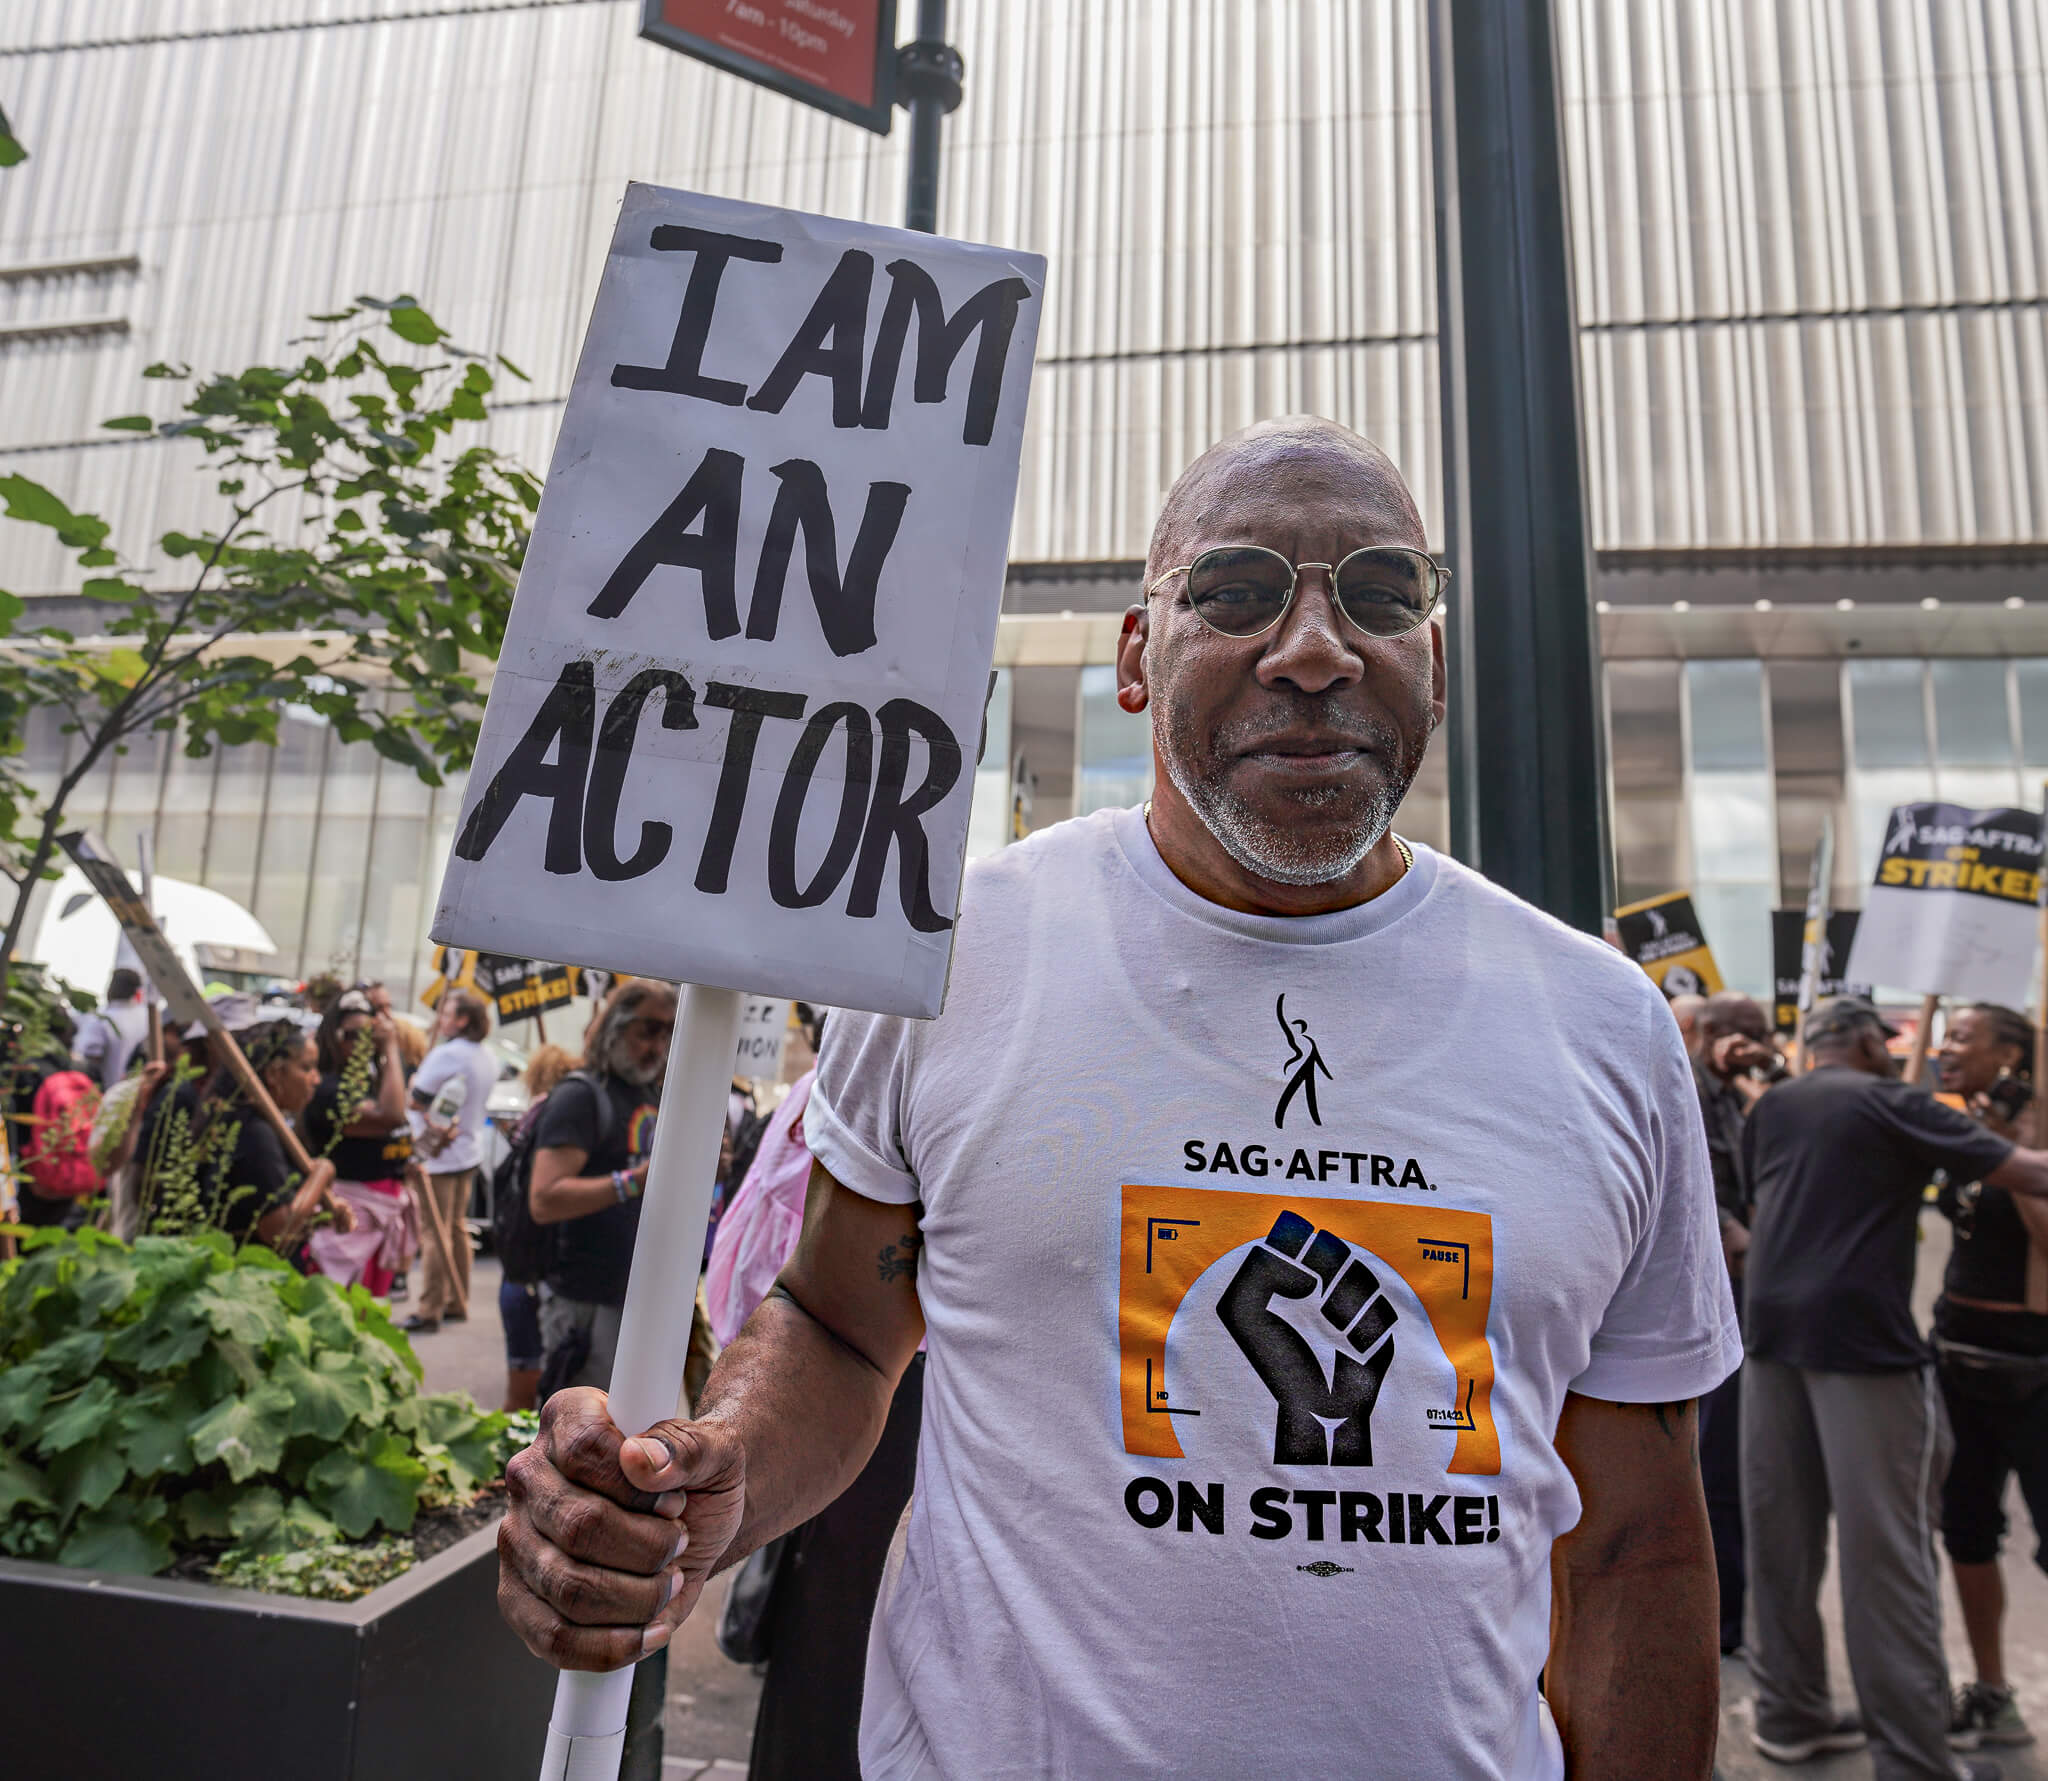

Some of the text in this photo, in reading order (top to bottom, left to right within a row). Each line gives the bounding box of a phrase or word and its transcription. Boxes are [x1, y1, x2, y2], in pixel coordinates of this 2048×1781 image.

[611, 224, 1030, 445] I AM
[587, 447, 912, 656] AN
[456, 661, 955, 931] ACTOR
[1880, 857, 2042, 902] STRIKE!
[1422, 1249, 1459, 1263] PAUSE
[1156, 1391, 1169, 1400] HD
[1124, 1476, 1501, 1546] ON STRIKE!
